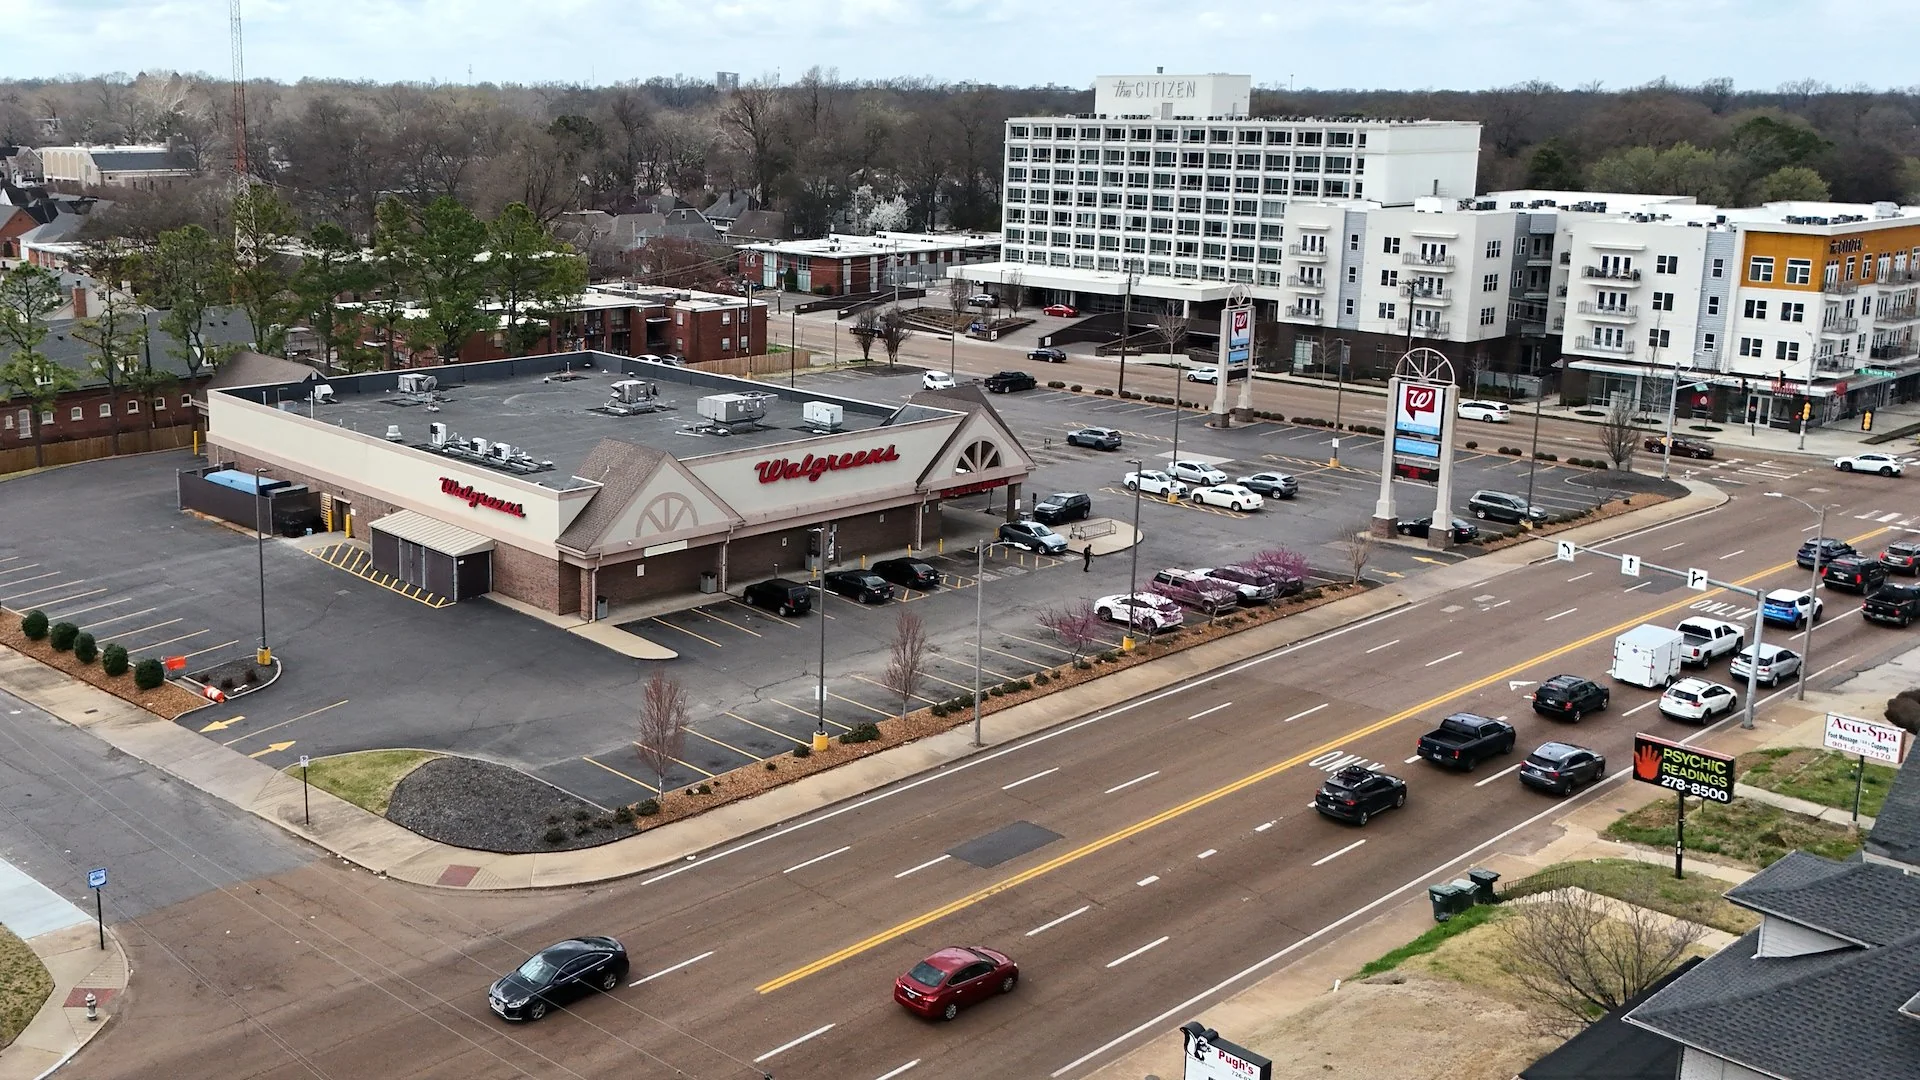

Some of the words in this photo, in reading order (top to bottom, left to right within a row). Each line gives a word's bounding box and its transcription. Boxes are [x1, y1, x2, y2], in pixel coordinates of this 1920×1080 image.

[1112, 80, 1134, 98] the
[1135, 80, 1196, 98] CITIZEN
[754, 444, 900, 484] Walgreens
[439, 477, 526, 518] Walgreens
[1689, 600, 1751, 617] ONLY
[1827, 731, 1838, 740] Foot
[1838, 732, 1858, 744] Massage
[1870, 742, 1889, 753] Cupping
[1831, 718, 1897, 742] Acu-Spa
[1663, 748, 1726, 774] PSYCHIC
[1662, 762, 1728, 787] READINGS
[1661, 775, 1728, 802] 278-8500
[1218, 1049, 1254, 1075] Pugh's
